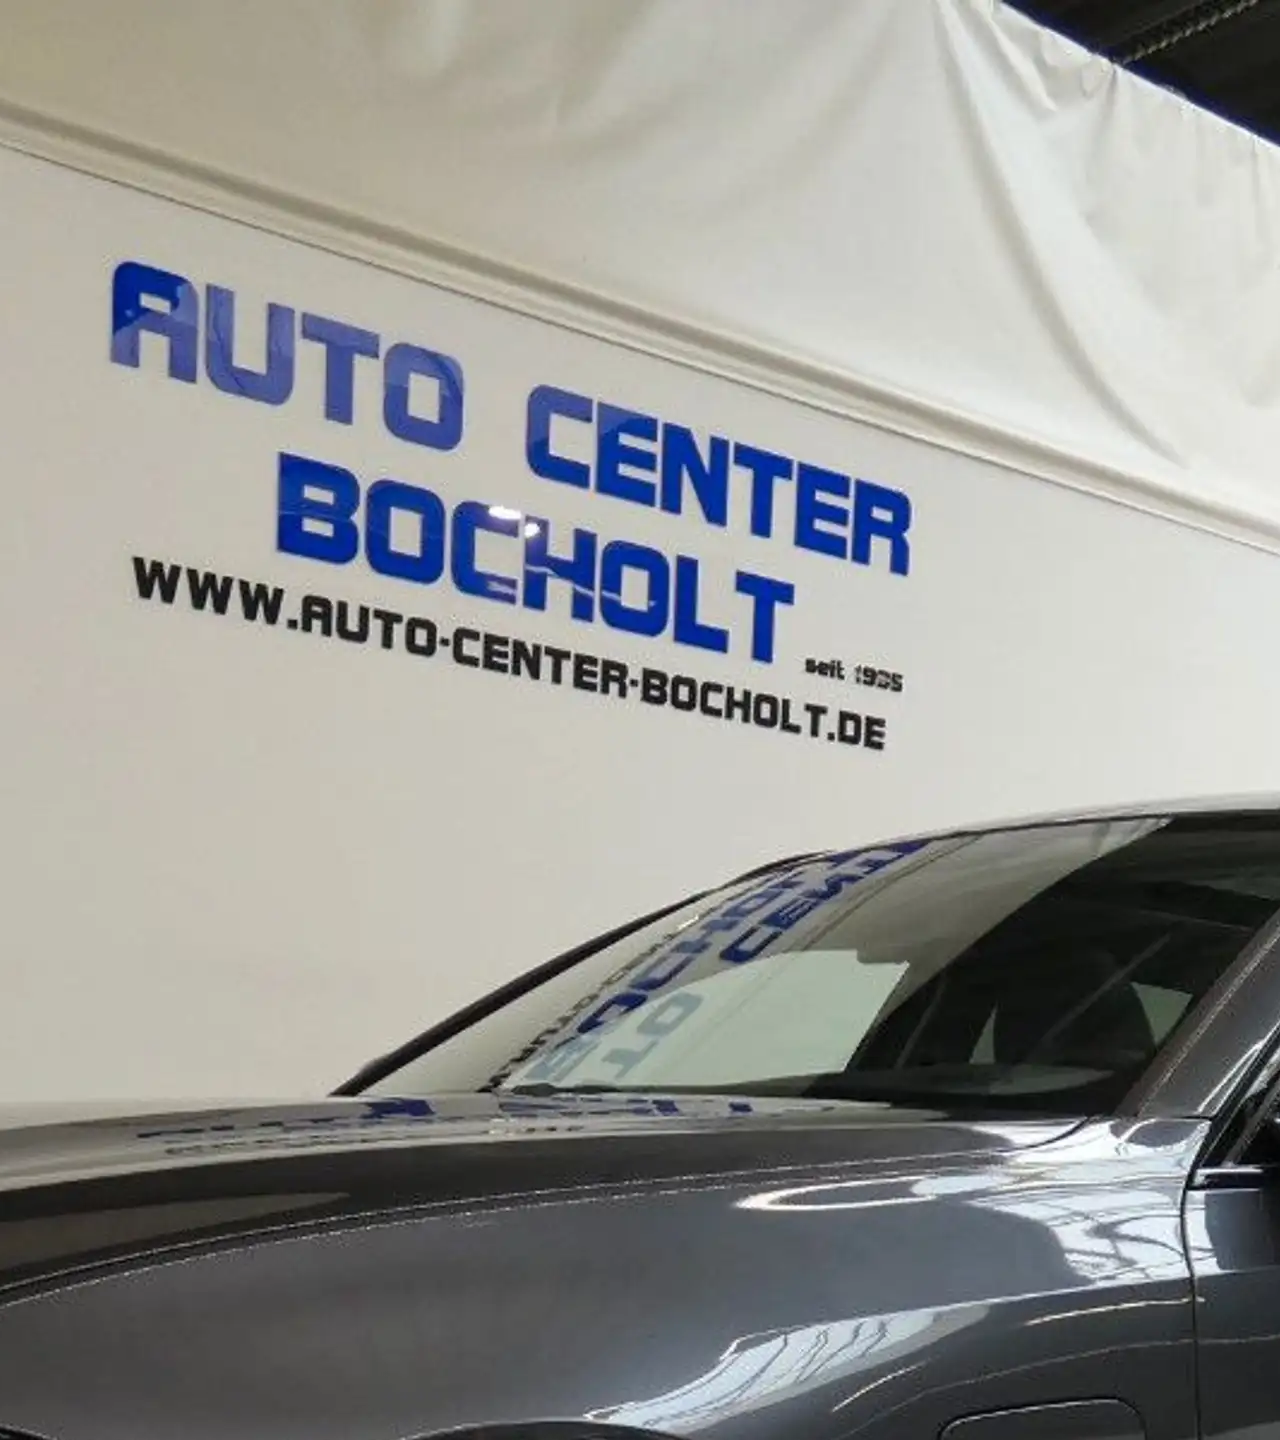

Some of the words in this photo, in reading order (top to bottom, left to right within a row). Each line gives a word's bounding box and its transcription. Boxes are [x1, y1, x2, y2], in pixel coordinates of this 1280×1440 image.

[111, 260, 464, 452] AUTO
[526, 385, 913, 578] CENTER
[132, 556, 887, 752] WWW.AUTO-CENTER-BOCHOLT.DE
[276, 452, 796, 665] BOCHOLT
[805, 657, 845, 681] seit
